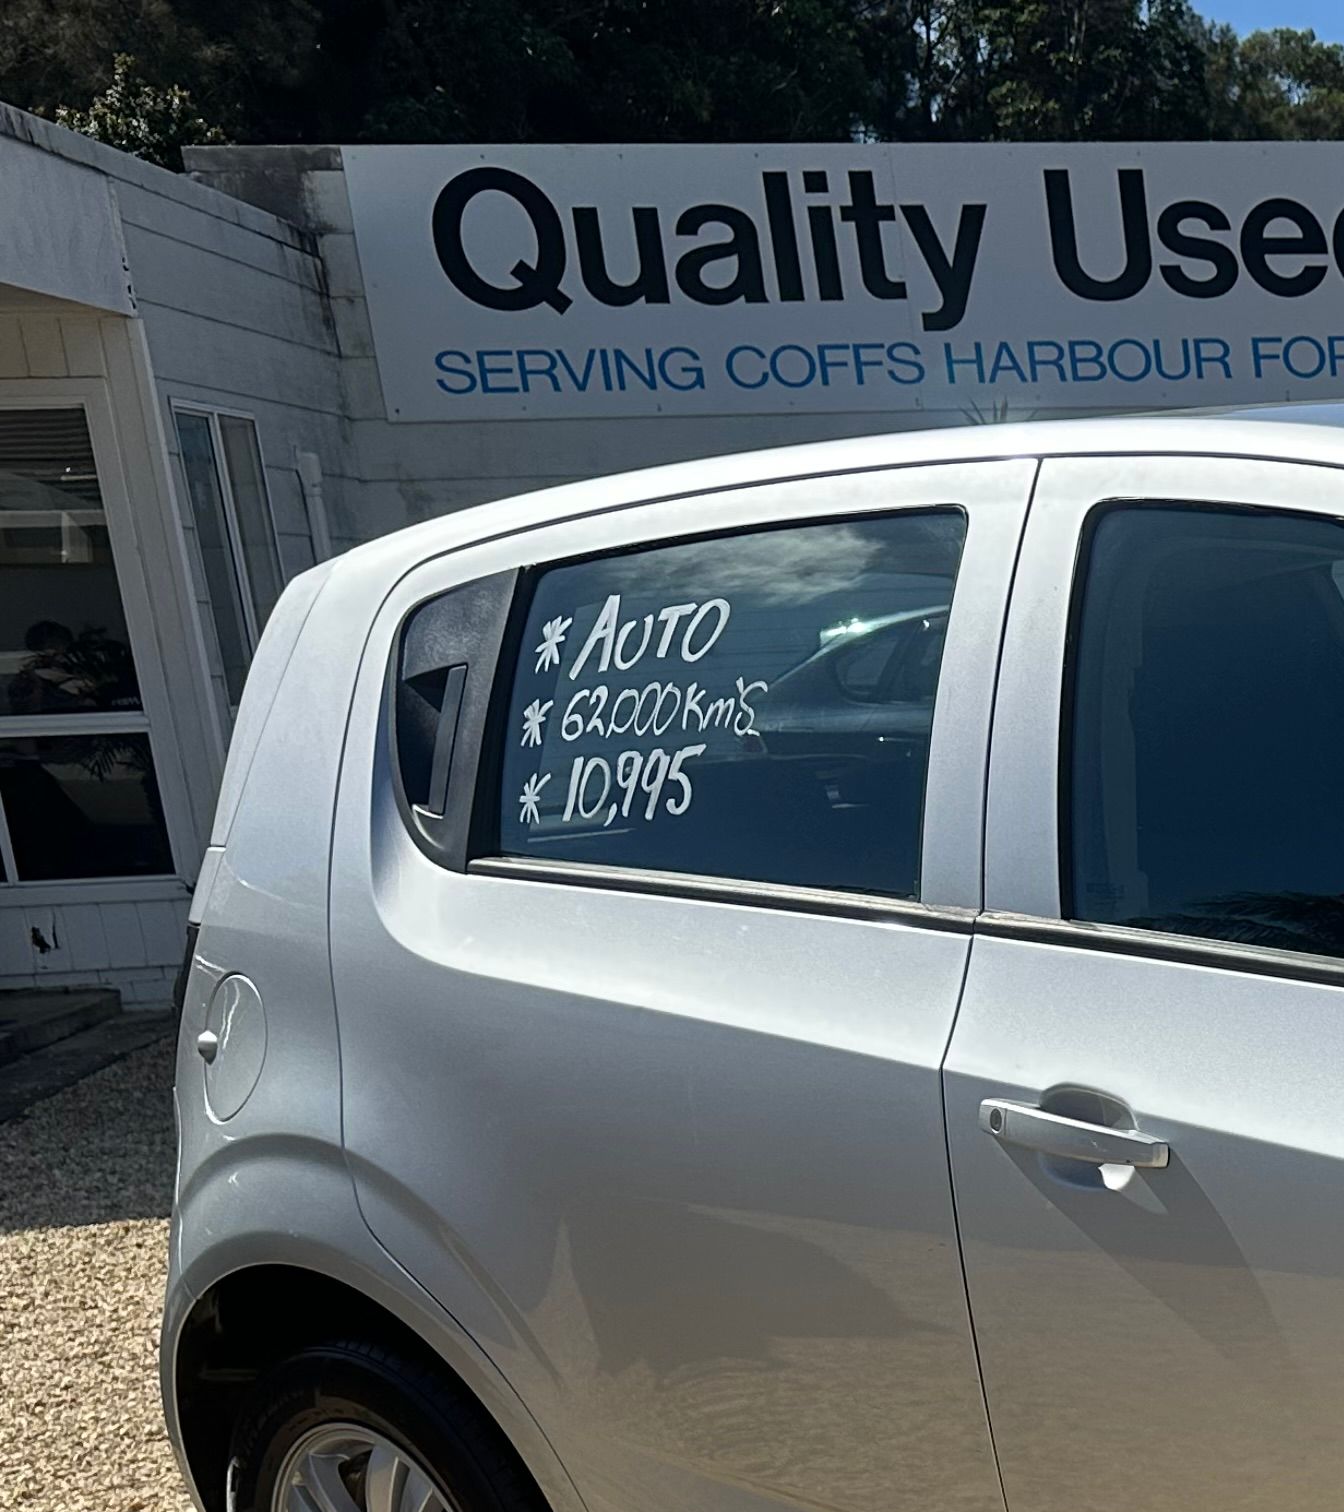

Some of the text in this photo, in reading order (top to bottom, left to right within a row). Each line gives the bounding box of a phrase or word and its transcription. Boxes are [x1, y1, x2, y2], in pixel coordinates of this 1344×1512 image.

[431, 166, 987, 331] Quality
[435, 346, 705, 395] SERVING
[726, 342, 925, 389] COFFS
[945, 336, 1232, 385] HARBOUR
[568, 594, 731, 681] AUTO
[562, 743, 707, 827] 10,995
